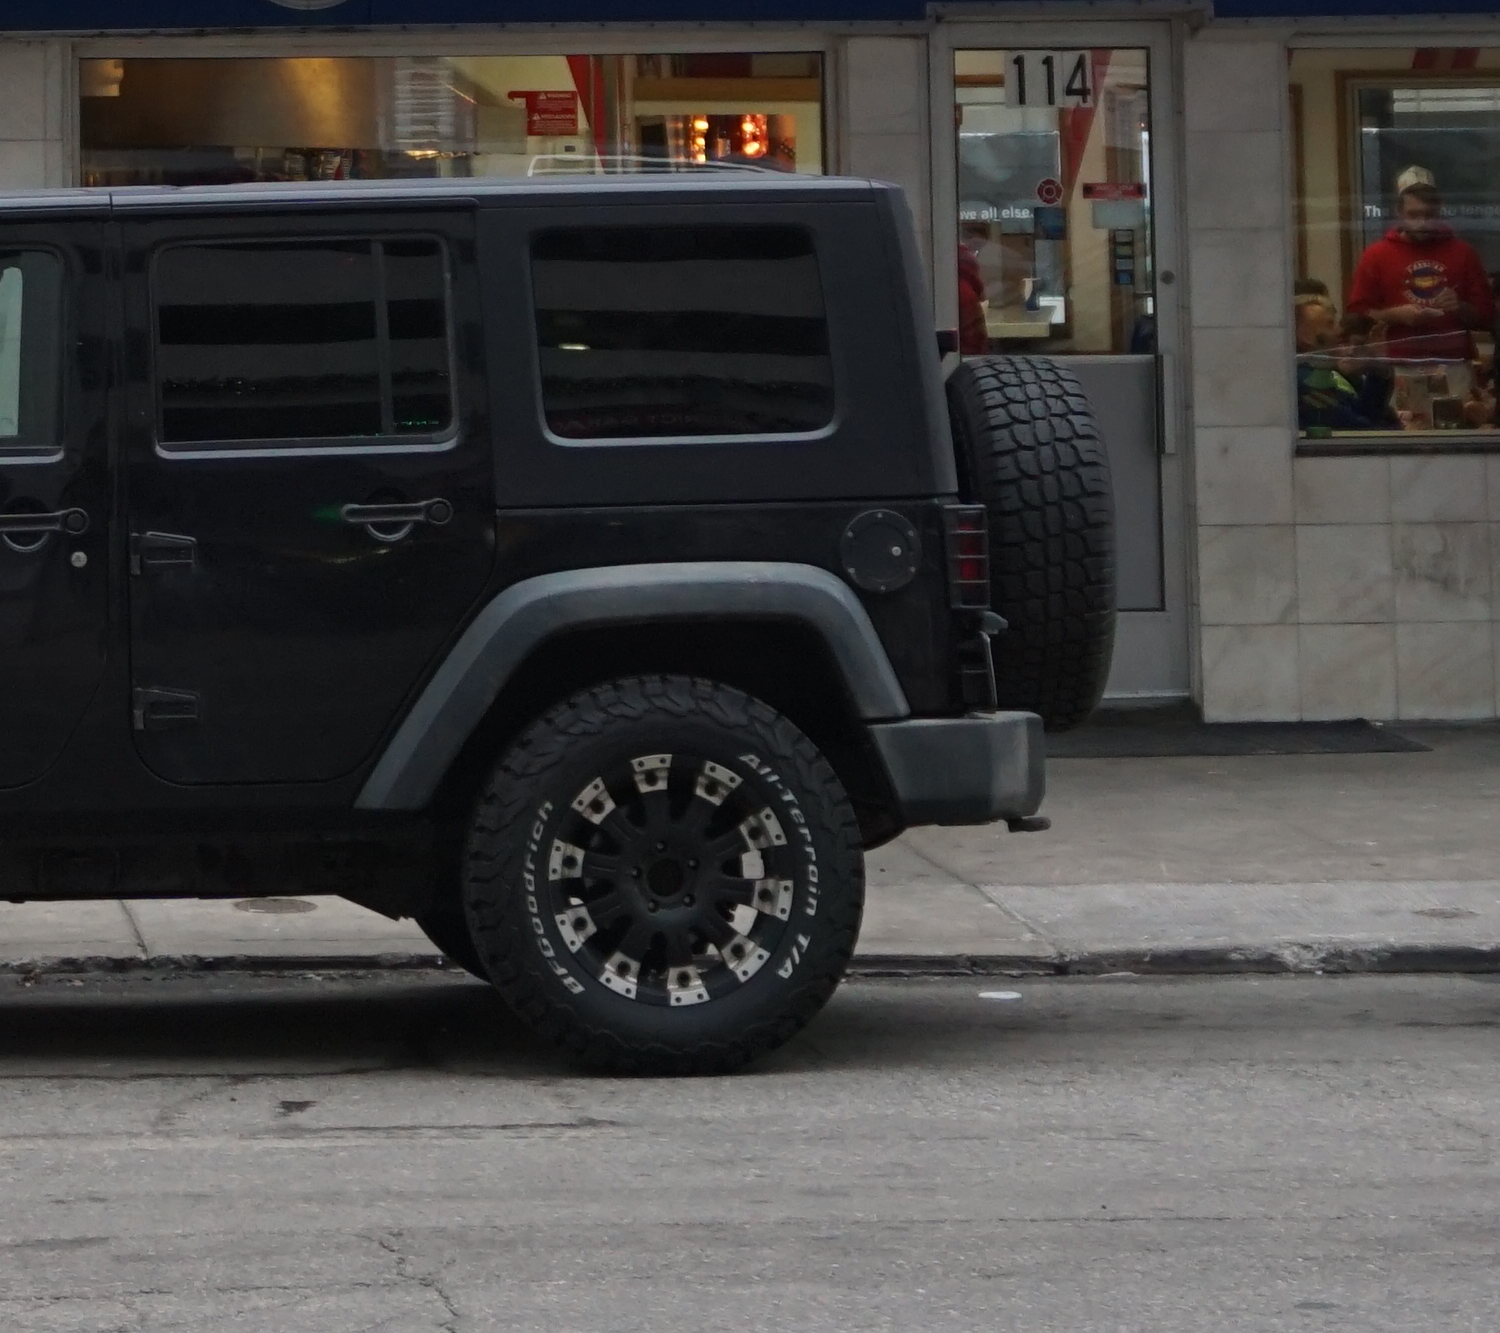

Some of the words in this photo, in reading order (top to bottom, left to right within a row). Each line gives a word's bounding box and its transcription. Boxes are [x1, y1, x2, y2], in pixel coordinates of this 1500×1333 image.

[1013, 53, 1091, 106] 114
[981, 206, 998, 220] all
[1001, 205, 1034, 219] else.
[738, 753, 822, 917] All-Terrain
[523, 800, 586, 995] BFGoodrich
[777, 933, 812, 980] T/A
